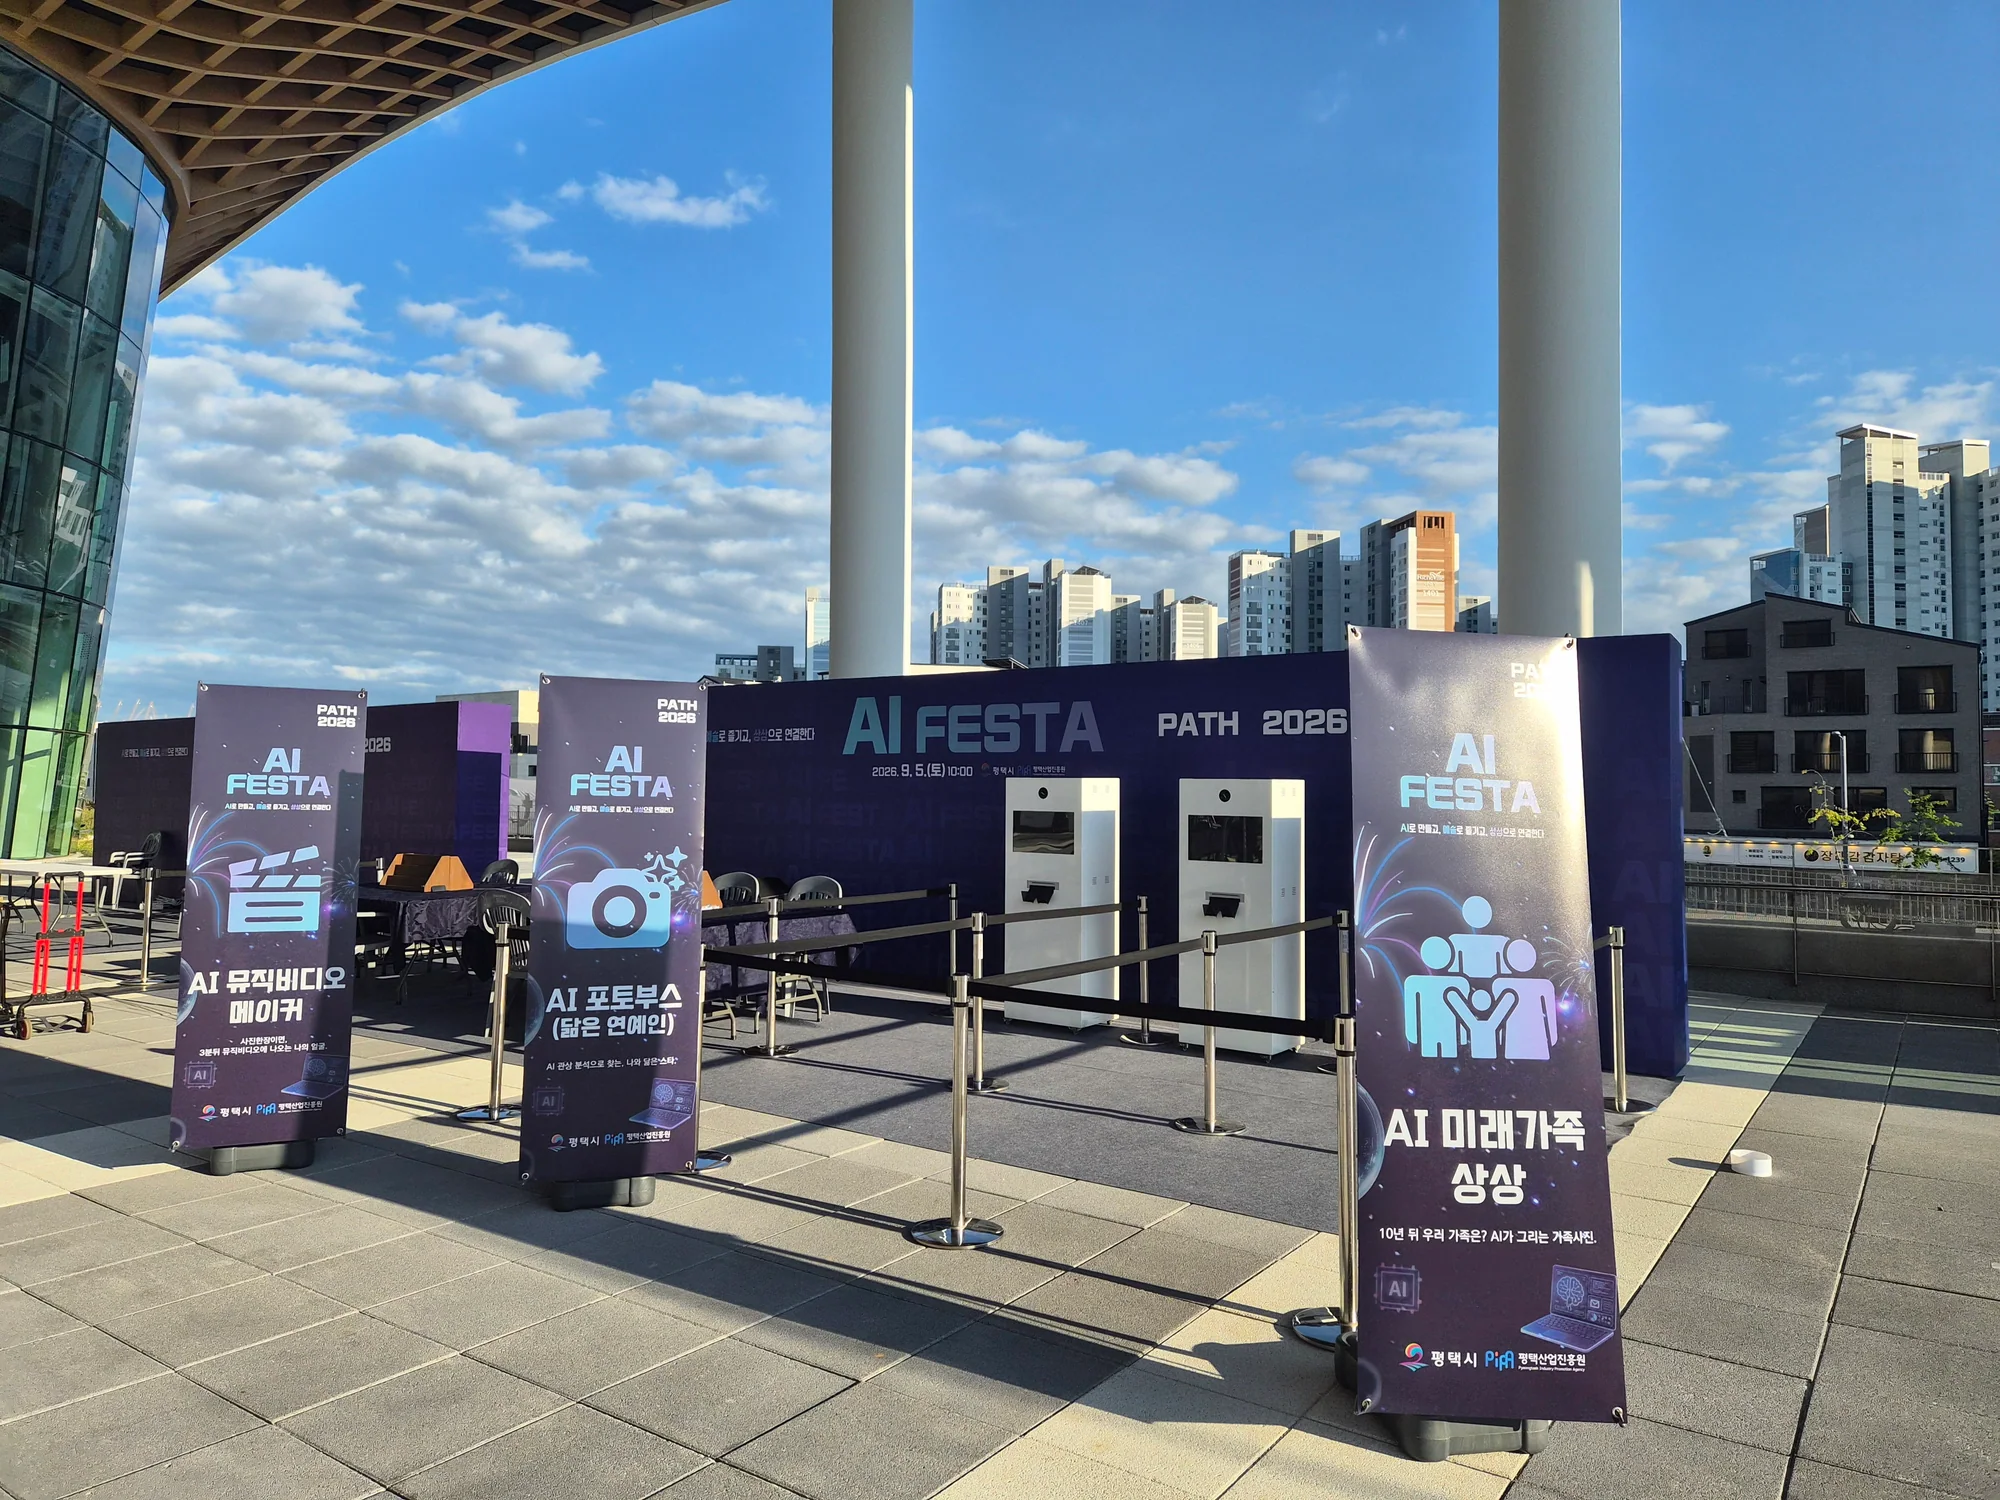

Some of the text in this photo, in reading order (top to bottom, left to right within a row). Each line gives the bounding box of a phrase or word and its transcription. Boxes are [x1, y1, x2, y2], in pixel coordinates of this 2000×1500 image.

[317, 705, 357, 716] PATH
[657, 699, 697, 711] PATH
[317, 717, 355, 727] 2026
[658, 712, 696, 723] 2026
[842, 696, 1103, 755] AI FESTA
[1158, 709, 1347, 737] PATH 2026
[785, 727, 815, 741] 연결한다
[262, 747, 301, 773] AI
[605, 746, 643, 773] AI
[1445, 733, 1496, 775] AI
[947, 766, 973, 777] 10:00
[227, 774, 331, 796] FESTA
[570, 774, 673, 798] FESTA
[1400, 775, 1542, 814] FESTA
[1400, 823, 1416, 833] AI로
[188, 966, 346, 994] AI 뮤직비디오
[545, 983, 682, 1012] AI 포토부스
[229, 998, 303, 1024] 메이커
[552, 1013, 675, 1041] (닮은 연예인)
[222, 1045, 267, 1055] 뮤직비디오에
[269, 1044, 292, 1053] 나오는
[294, 1043, 309, 1052] 나의
[546, 1062, 555, 1070] AI
[557, 1062, 572, 1071] 관상
[575, 1060, 604, 1070] 분석으로
[626, 1058, 641, 1067] 나와
[193, 1070, 208, 1081] AI
[220, 1106, 251, 1118] 평택시
[278, 1101, 323, 1111] 평택산업진흥원
[569, 1136, 600, 1148] 평택시
[626, 1130, 671, 1141] 평택산업진흥원
[1384, 1108, 1586, 1152] AI 미래가족
[1450, 1163, 1526, 1205] 상상
[1379, 1227, 1597, 1245] 10년 뒤 우리 가족은? AI가 그리는 가족사진.
[1388, 1280, 1408, 1298] AI
[1431, 1350, 1477, 1368] 평택시
[1518, 1352, 1586, 1366] 평택산업진흥원
